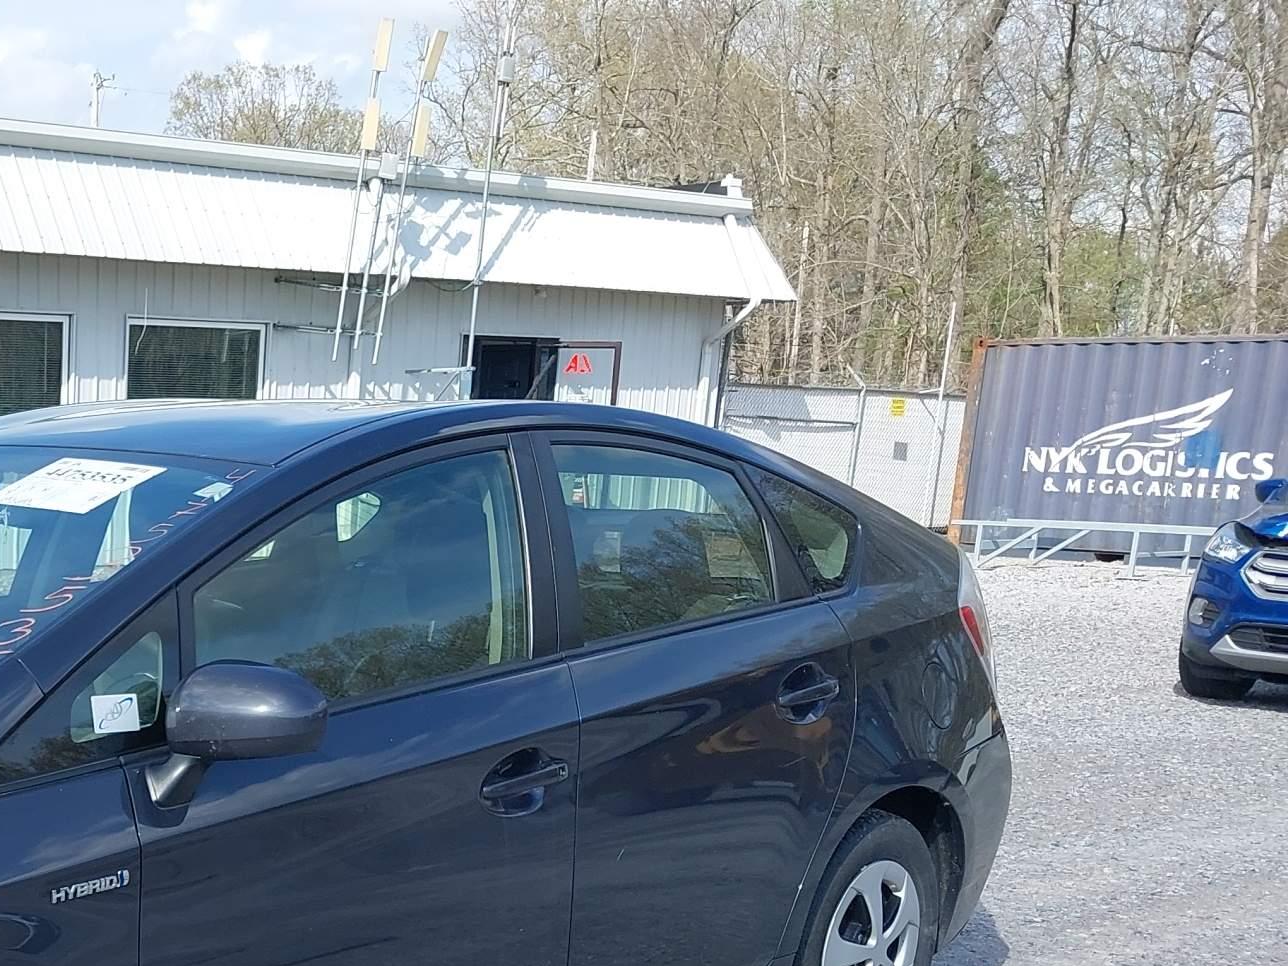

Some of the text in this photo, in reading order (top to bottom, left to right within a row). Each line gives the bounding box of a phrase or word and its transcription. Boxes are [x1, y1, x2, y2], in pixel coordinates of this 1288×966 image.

[1022, 446, 1088, 473] NYK
[1043, 477, 1241, 500] & MEGACARRIER
[51, 875, 117, 904] HYBRID
